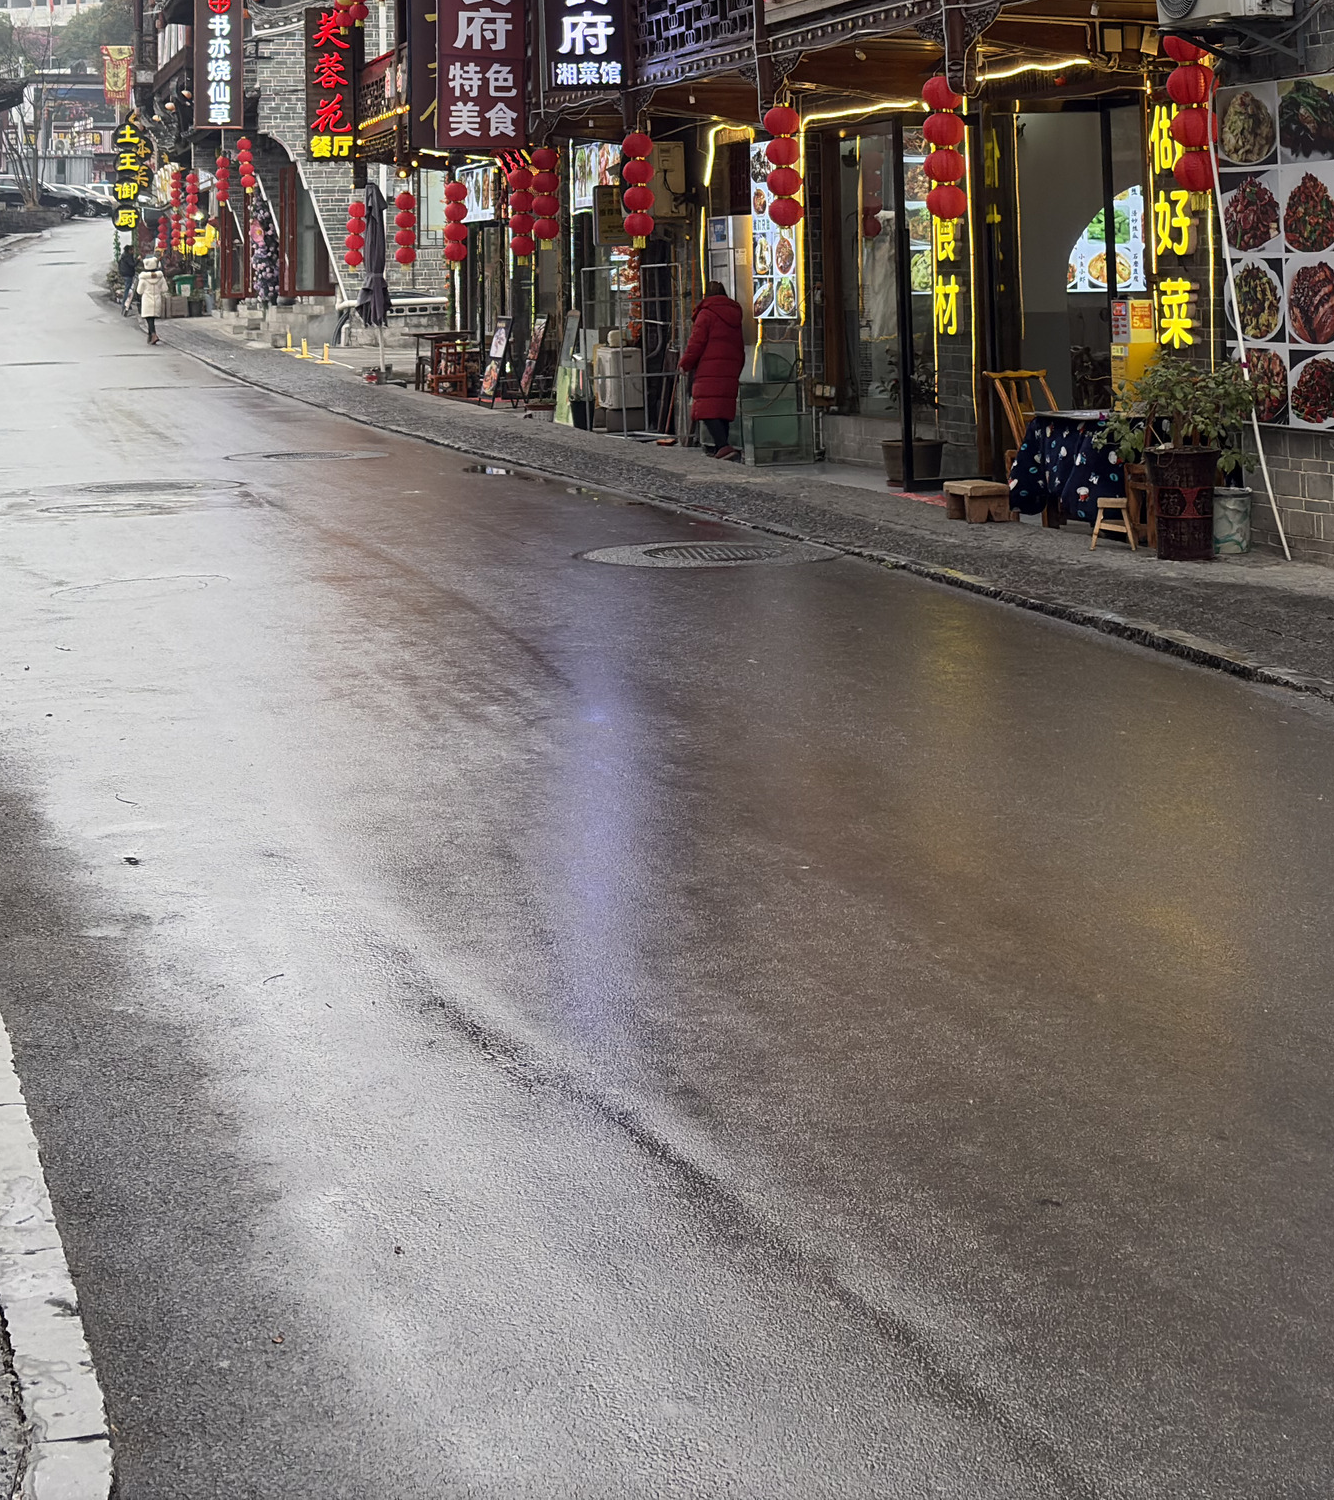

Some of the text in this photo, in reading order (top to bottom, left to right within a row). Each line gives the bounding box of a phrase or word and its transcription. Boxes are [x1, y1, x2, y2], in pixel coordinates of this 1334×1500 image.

[207, 14, 231, 126] 书亦烧仙草
[310, 9, 353, 133] 芙蓉花
[448, 63, 518, 98] 特色
[556, 61, 623, 86] 湘菜馆
[310, 135, 354, 158] 餐厅
[448, 101, 518, 138] 美食
[114, 124, 140, 229] 土王御厨
[1150, 102, 1194, 350] 做好菜
